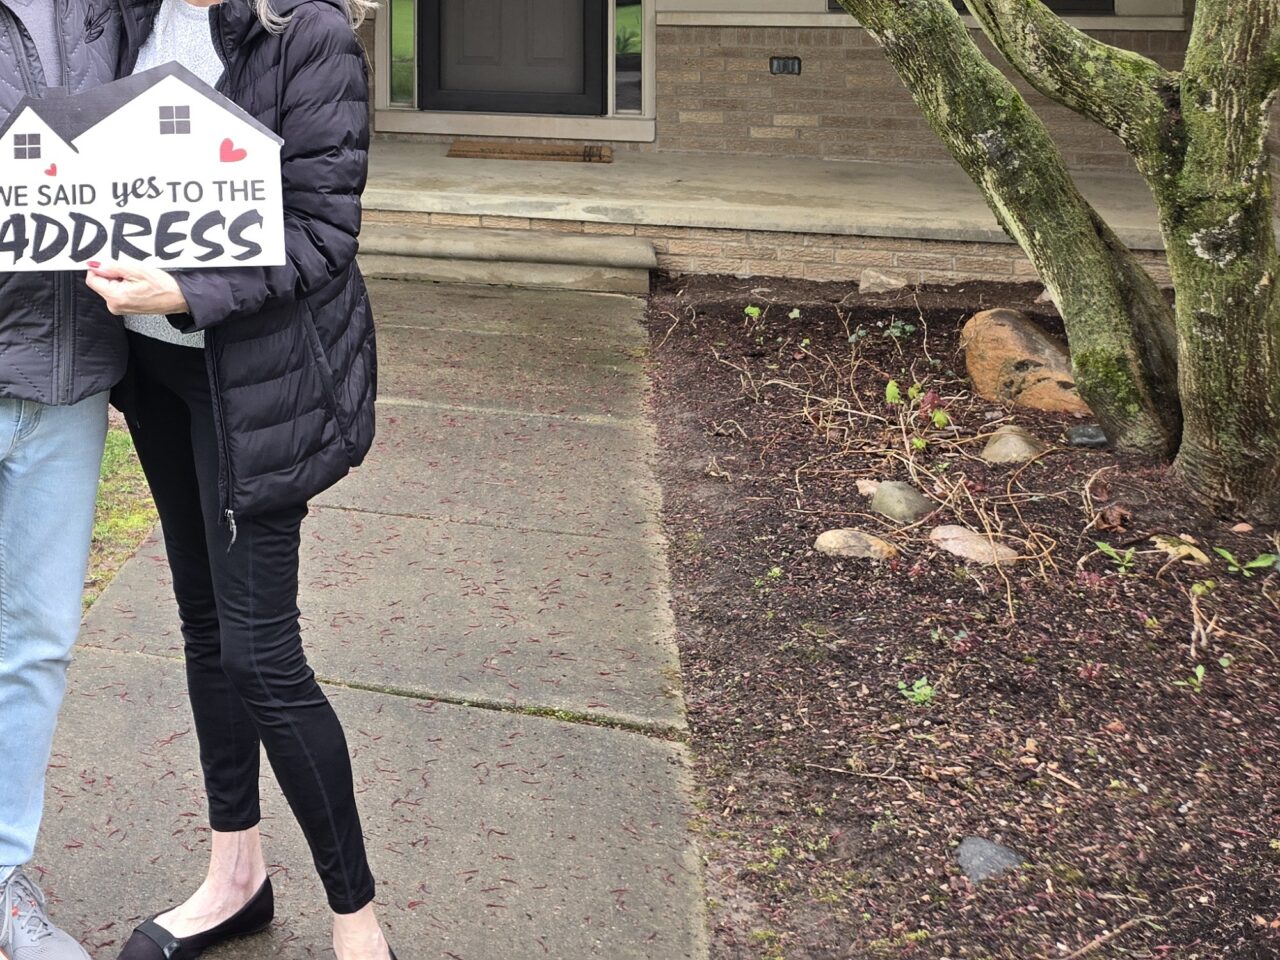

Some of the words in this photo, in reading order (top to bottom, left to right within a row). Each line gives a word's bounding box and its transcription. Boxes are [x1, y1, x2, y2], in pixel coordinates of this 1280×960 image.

[37, 183, 96, 207] SAID
[112, 176, 164, 208] yes
[166, 180, 204, 203] TO
[212, 179, 266, 202] THE
